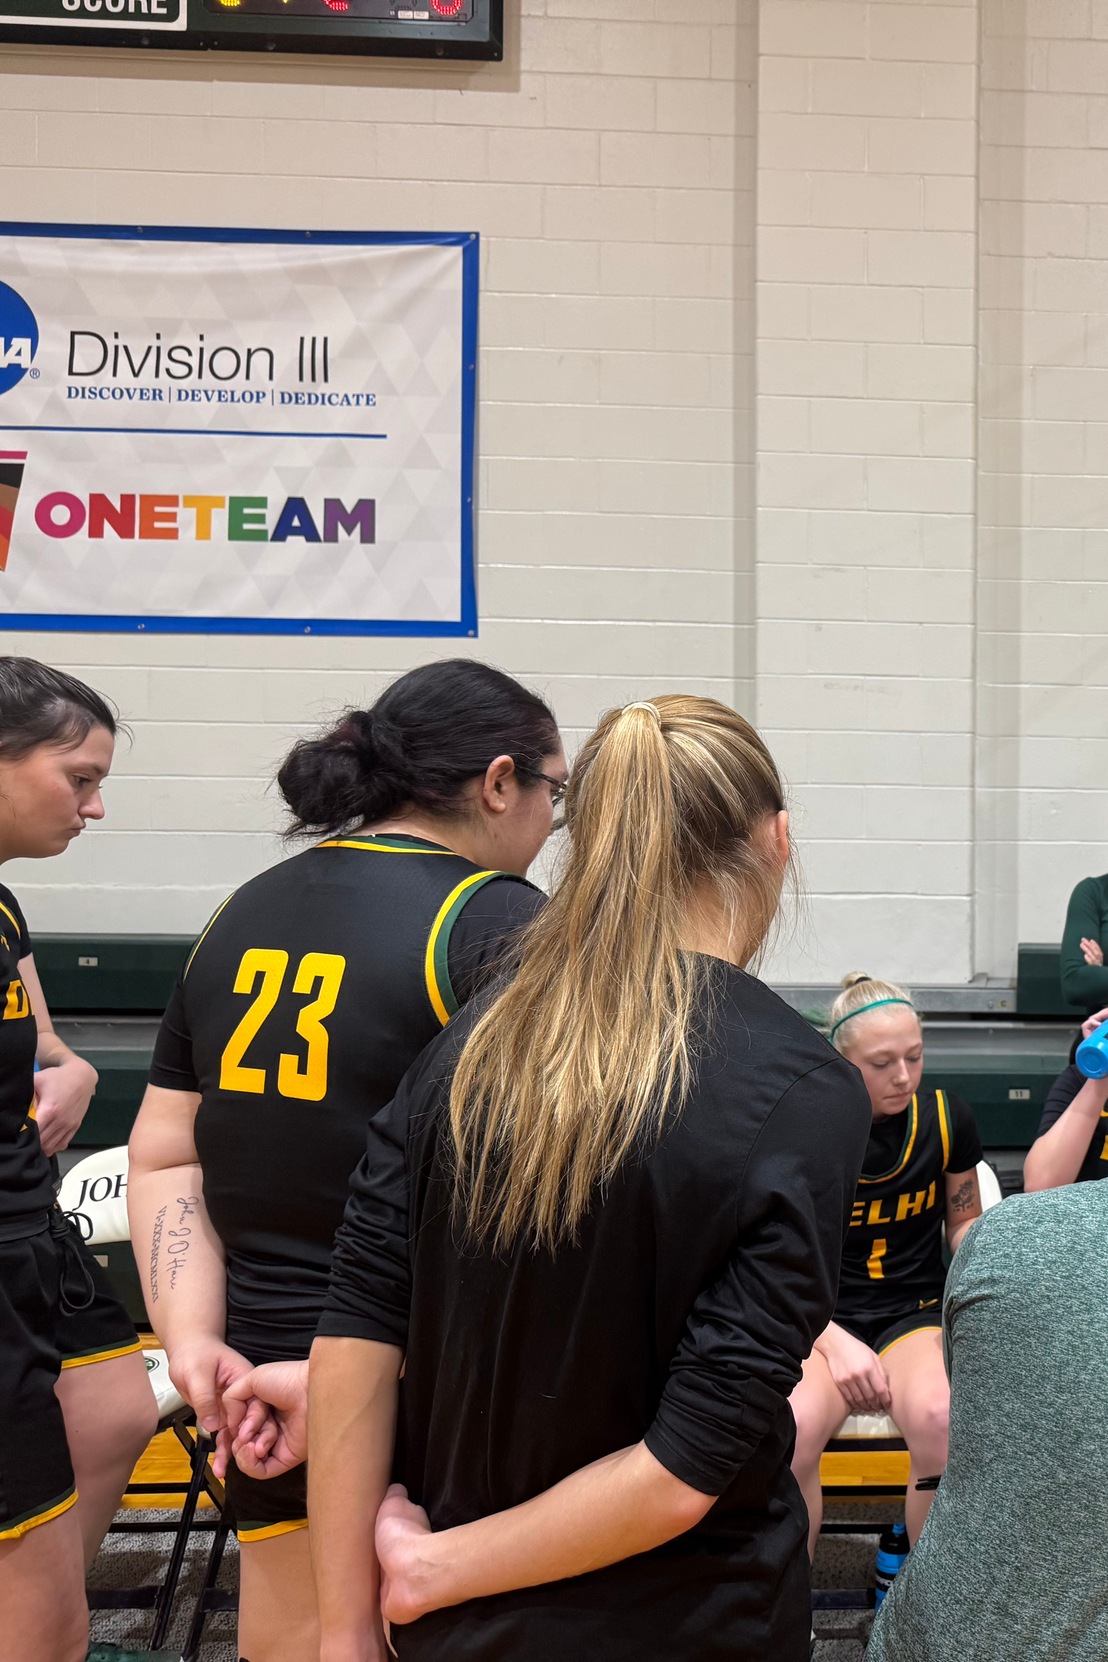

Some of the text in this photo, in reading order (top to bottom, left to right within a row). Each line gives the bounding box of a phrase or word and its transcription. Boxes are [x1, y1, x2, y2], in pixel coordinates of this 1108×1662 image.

[68, 330, 329, 383] Division III
[66, 386, 377, 407] DISCOVER DEVELOP DEDICATE
[34, 491, 376, 544] ONETEAM
[219, 948, 346, 1102] 23
[866, 1238, 888, 1279] 1
